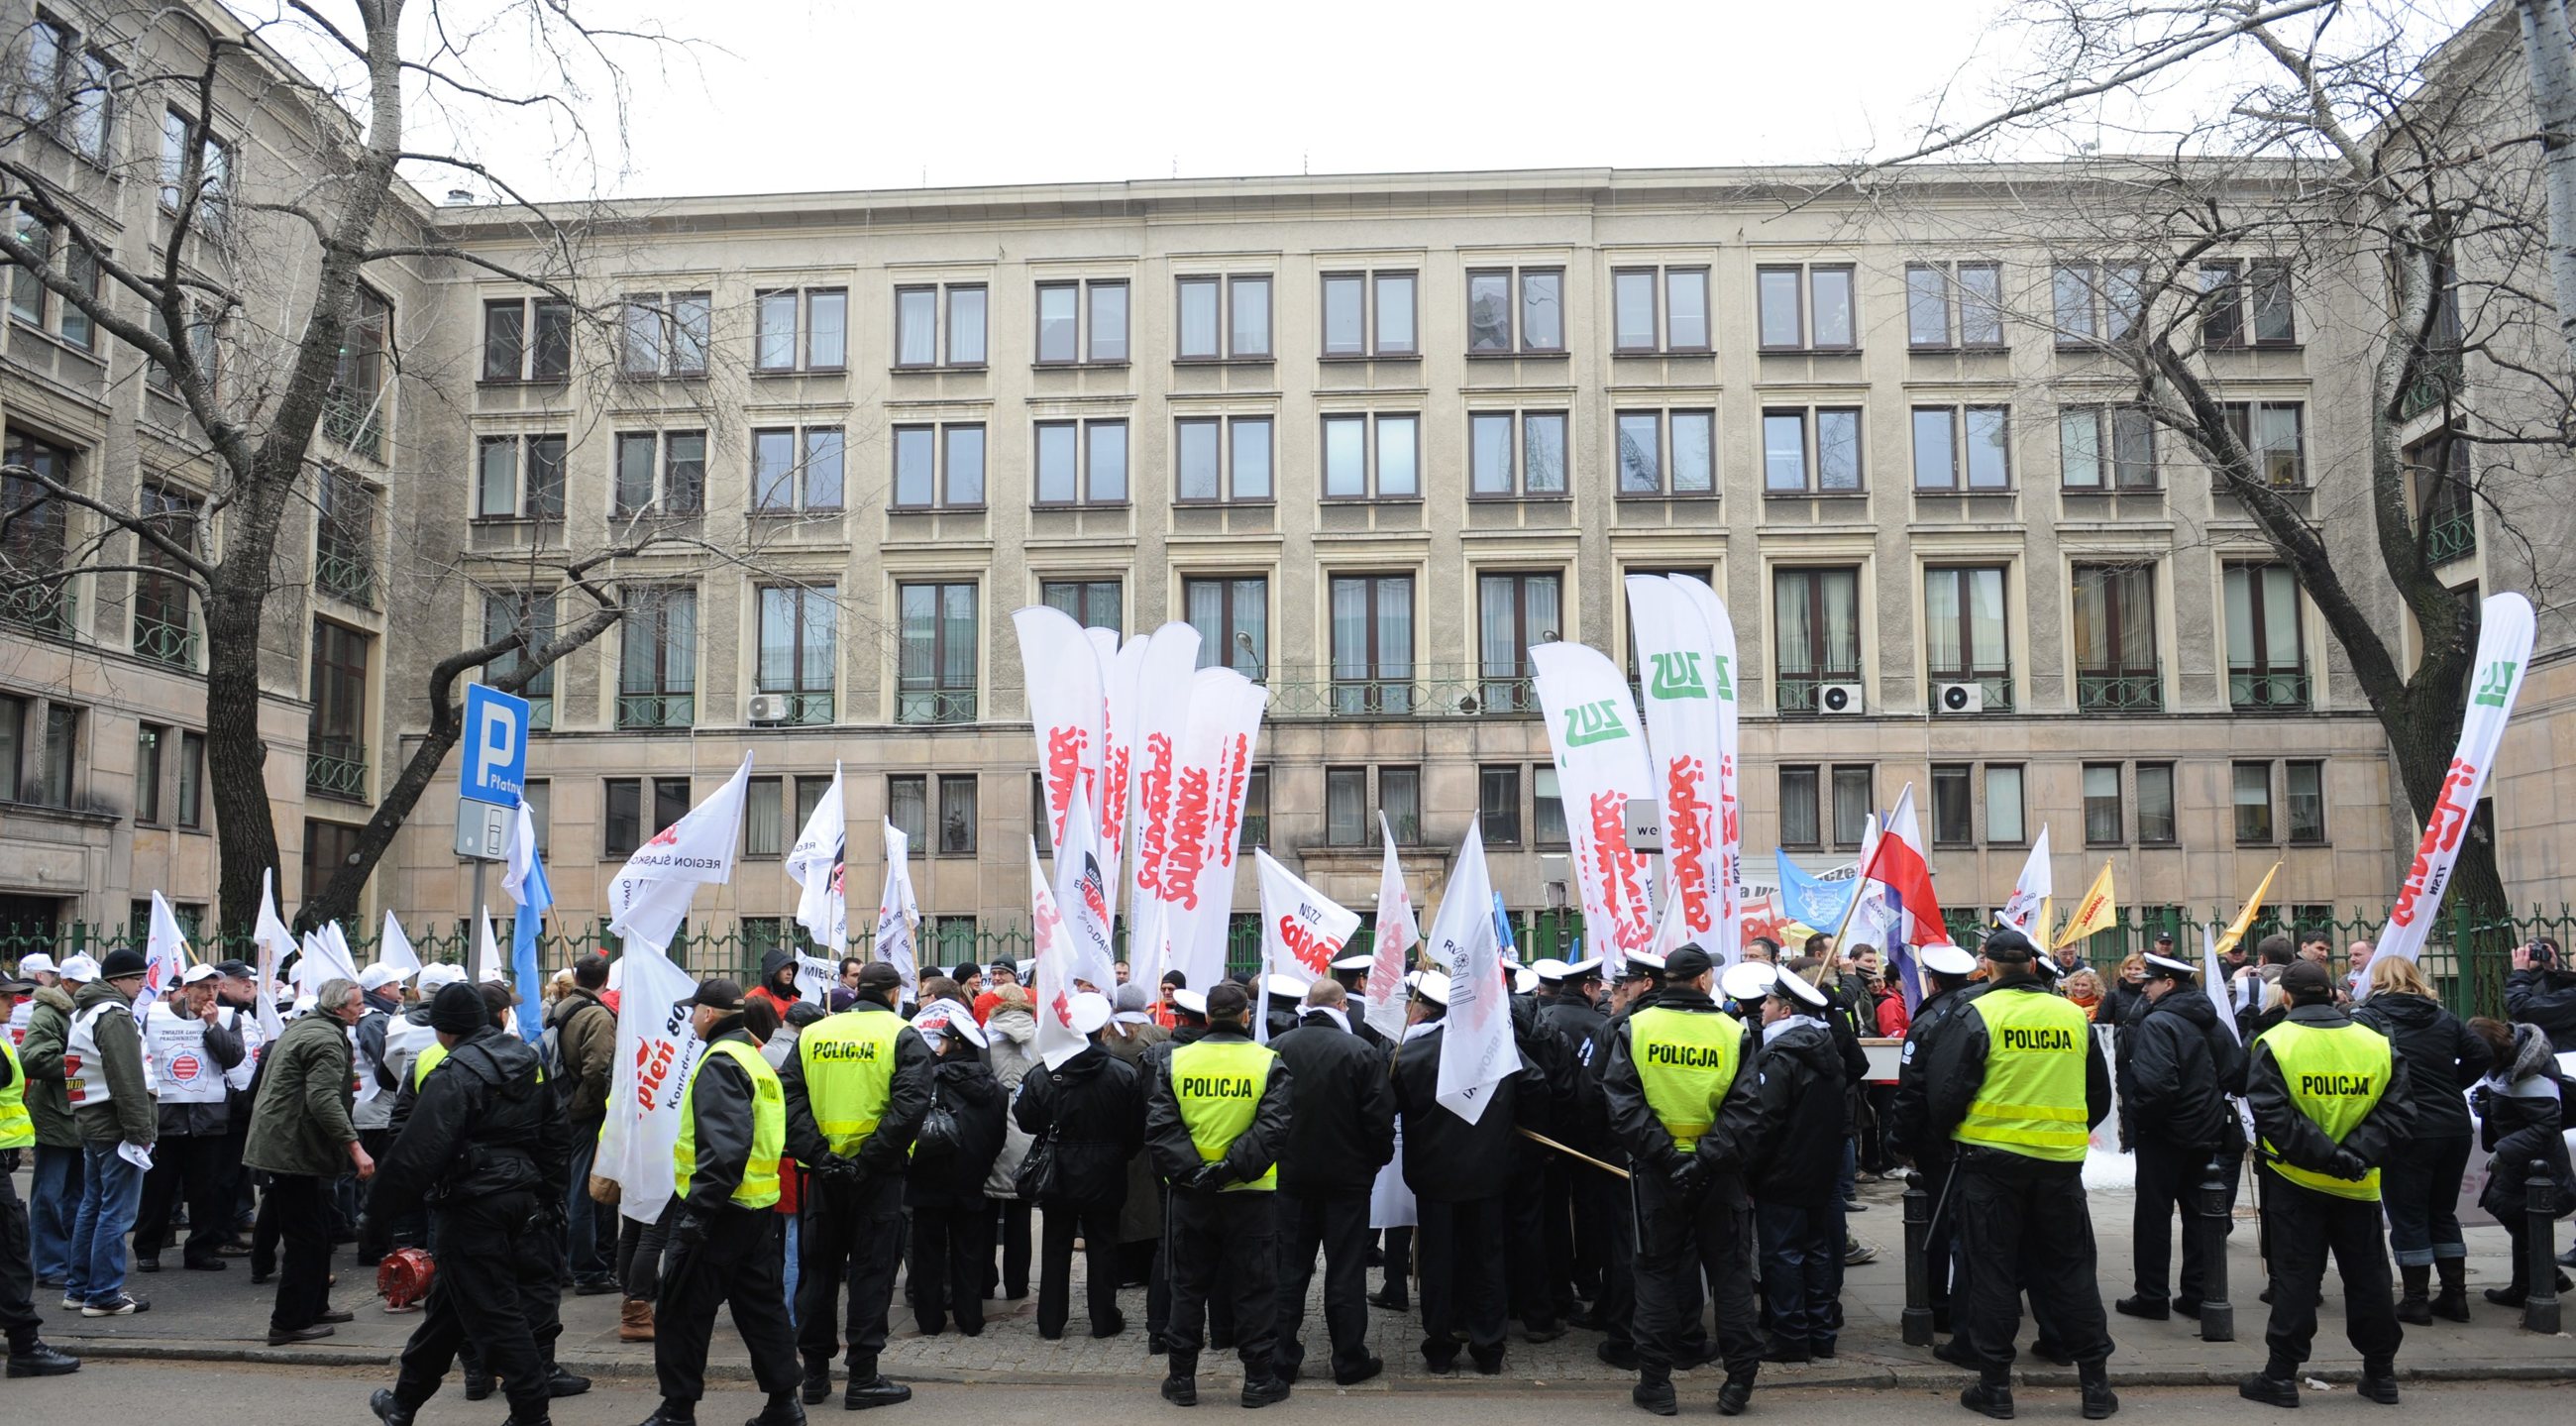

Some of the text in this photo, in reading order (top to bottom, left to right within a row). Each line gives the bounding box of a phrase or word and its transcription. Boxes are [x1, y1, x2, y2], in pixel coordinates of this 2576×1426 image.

[477, 700, 516, 788] P
[1299, 902, 1323, 926] NSZZ
[667, 1004, 686, 1038] 80
[2004, 1029, 2073, 1049] POLICJA
[813, 1041, 874, 1060] POLICJA
[1648, 1043, 1719, 1068] POLICJA
[1183, 1077, 1252, 1098] POLICJA
[2302, 1075, 2370, 1096] POLICJA
